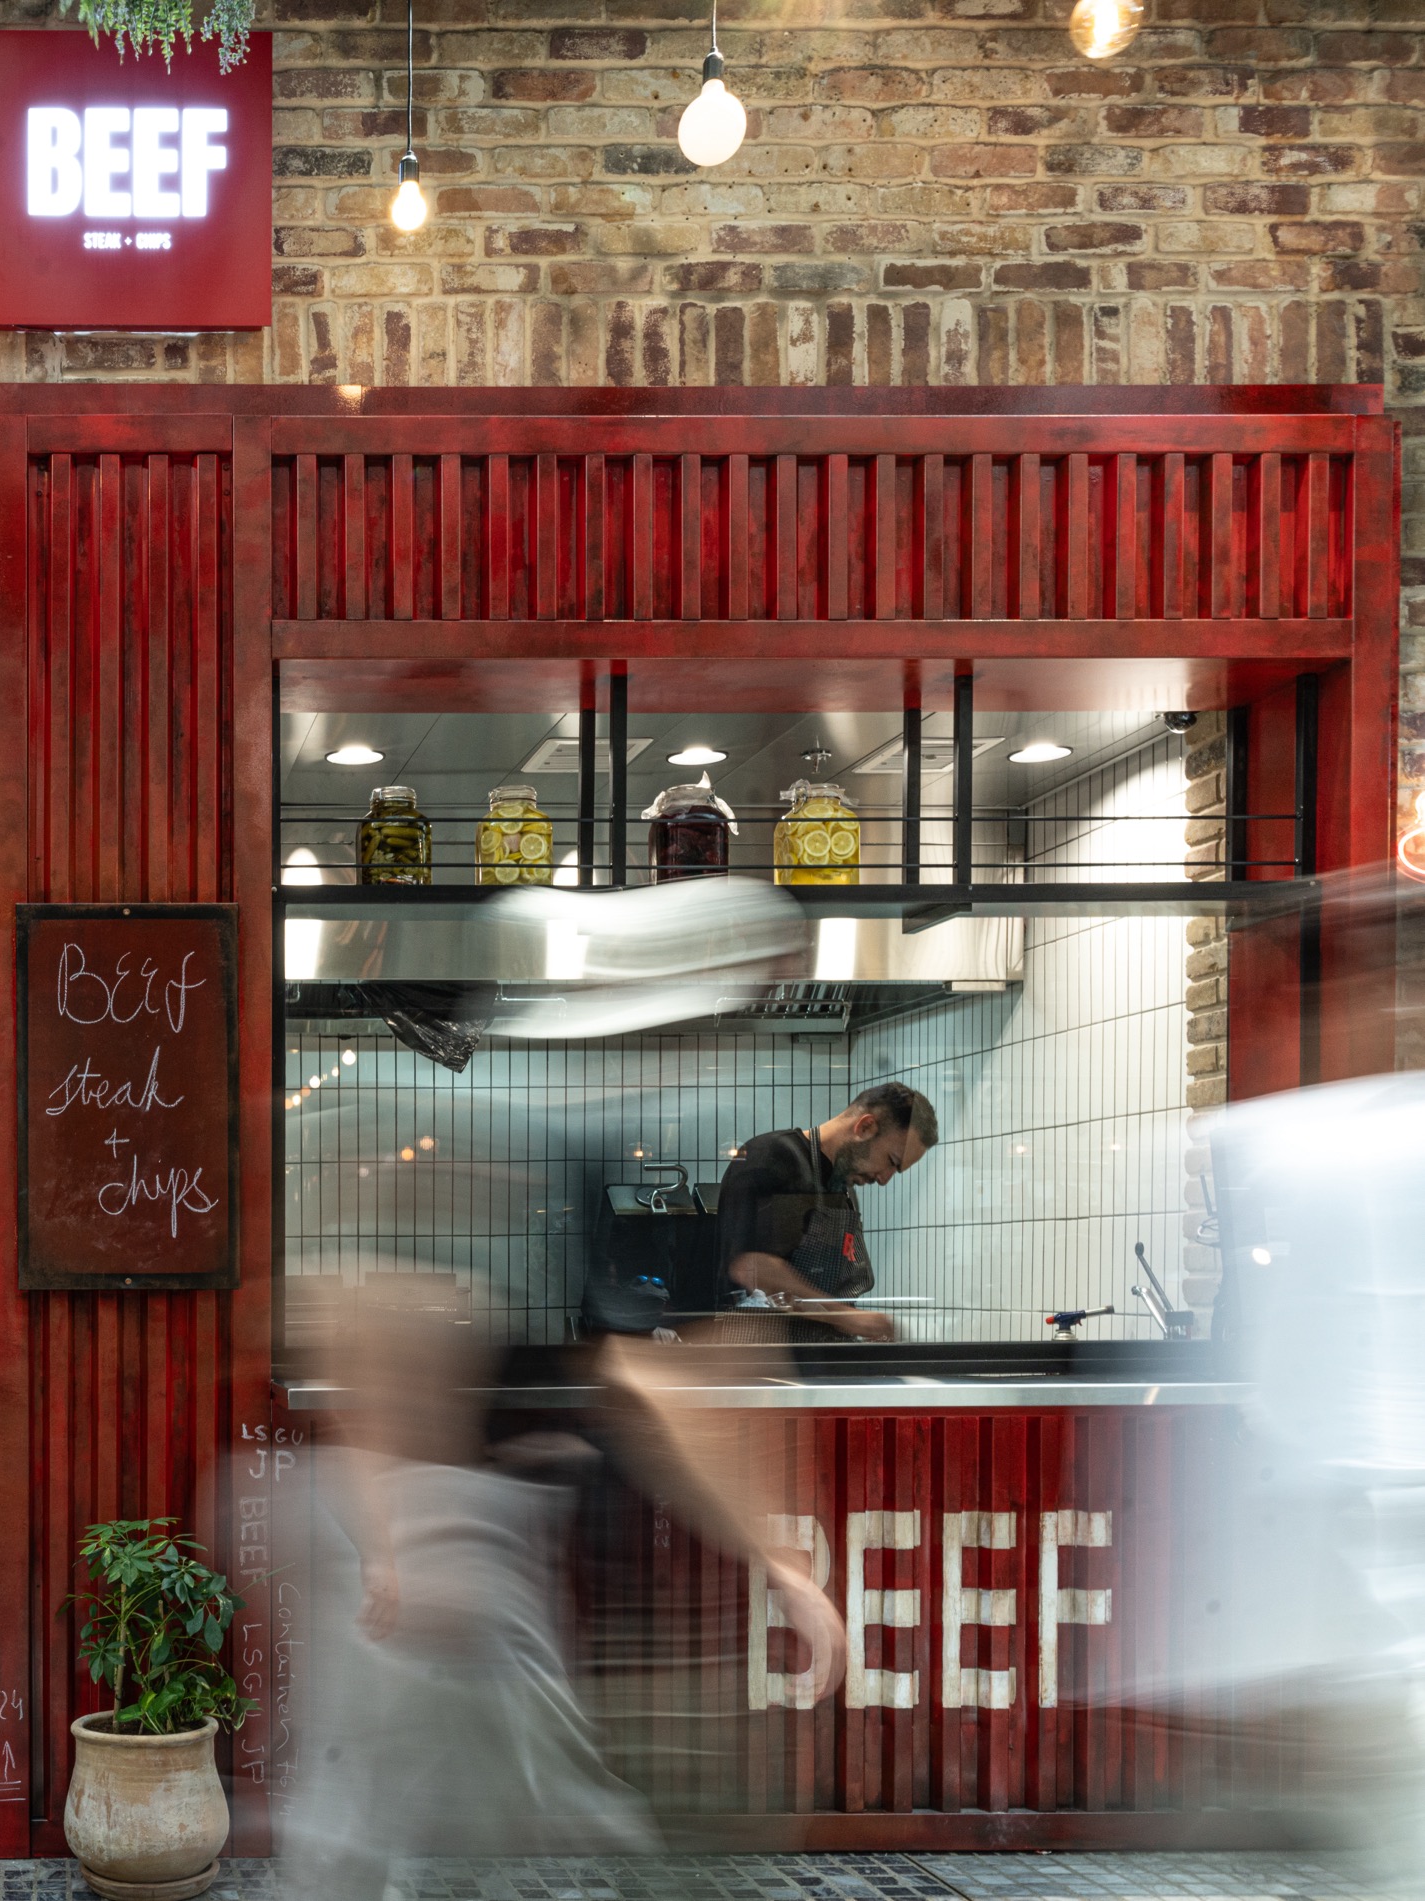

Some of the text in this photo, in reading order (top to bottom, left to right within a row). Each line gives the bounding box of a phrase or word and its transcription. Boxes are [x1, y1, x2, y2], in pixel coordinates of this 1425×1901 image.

[27, 106, 229, 218] BEEF
[83, 232, 122, 250] STEAK
[45, 1045, 184, 1116] steak
[98, 1154, 219, 1238] chips
